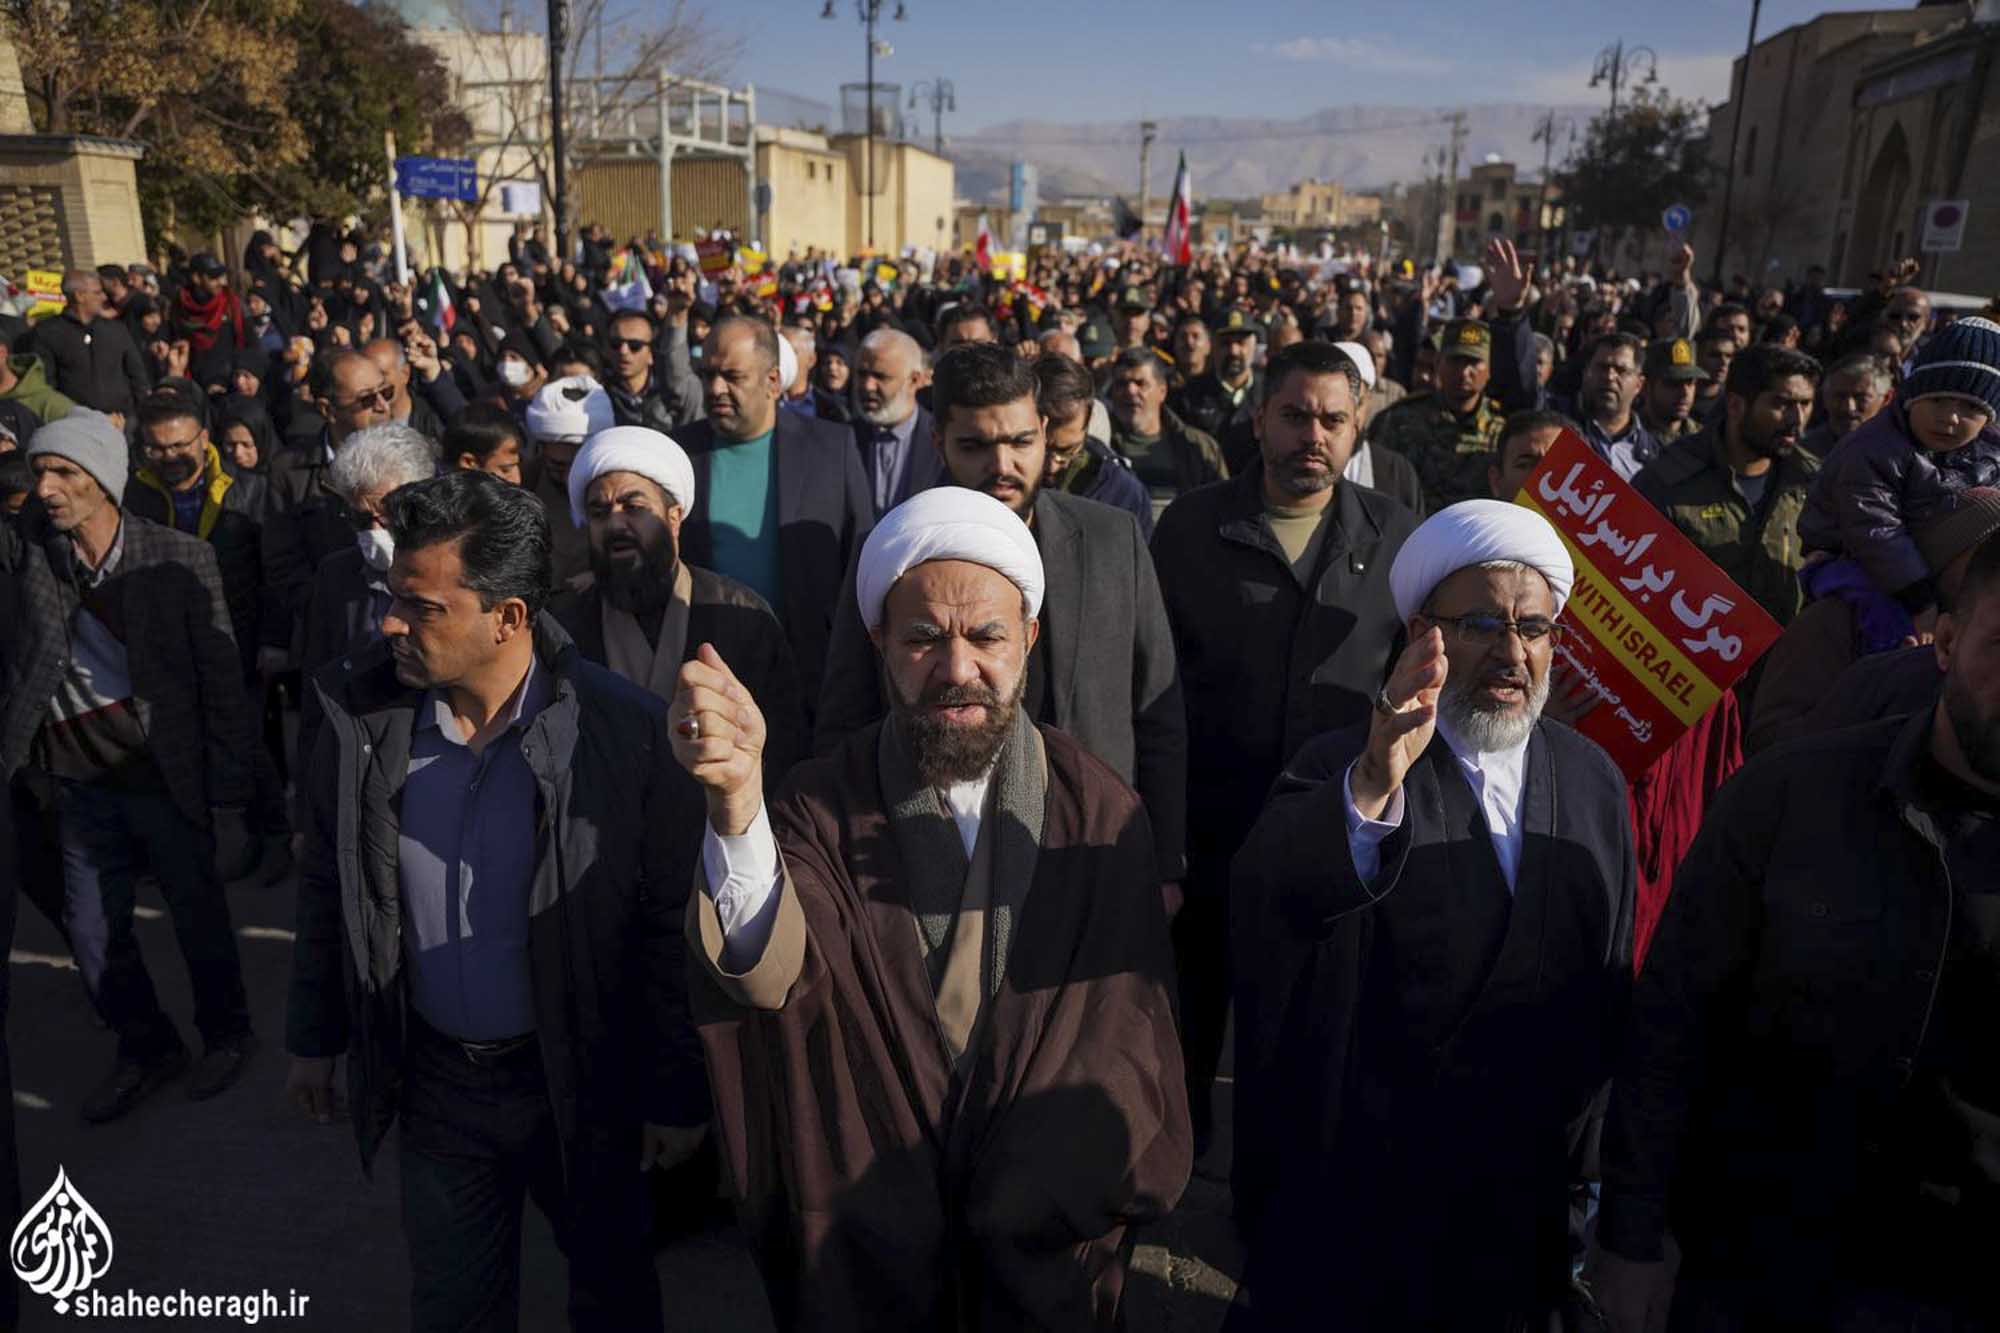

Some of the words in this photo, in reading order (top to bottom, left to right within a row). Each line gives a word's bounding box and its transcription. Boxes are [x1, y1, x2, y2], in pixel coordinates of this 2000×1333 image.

[1538, 462, 1659, 566] اسرائیل
[1619, 564, 1675, 604] بر
[1670, 588, 1743, 662] مرگ
[1573, 568, 1624, 633] WITH
[1615, 623, 1696, 707] ISRAEL
